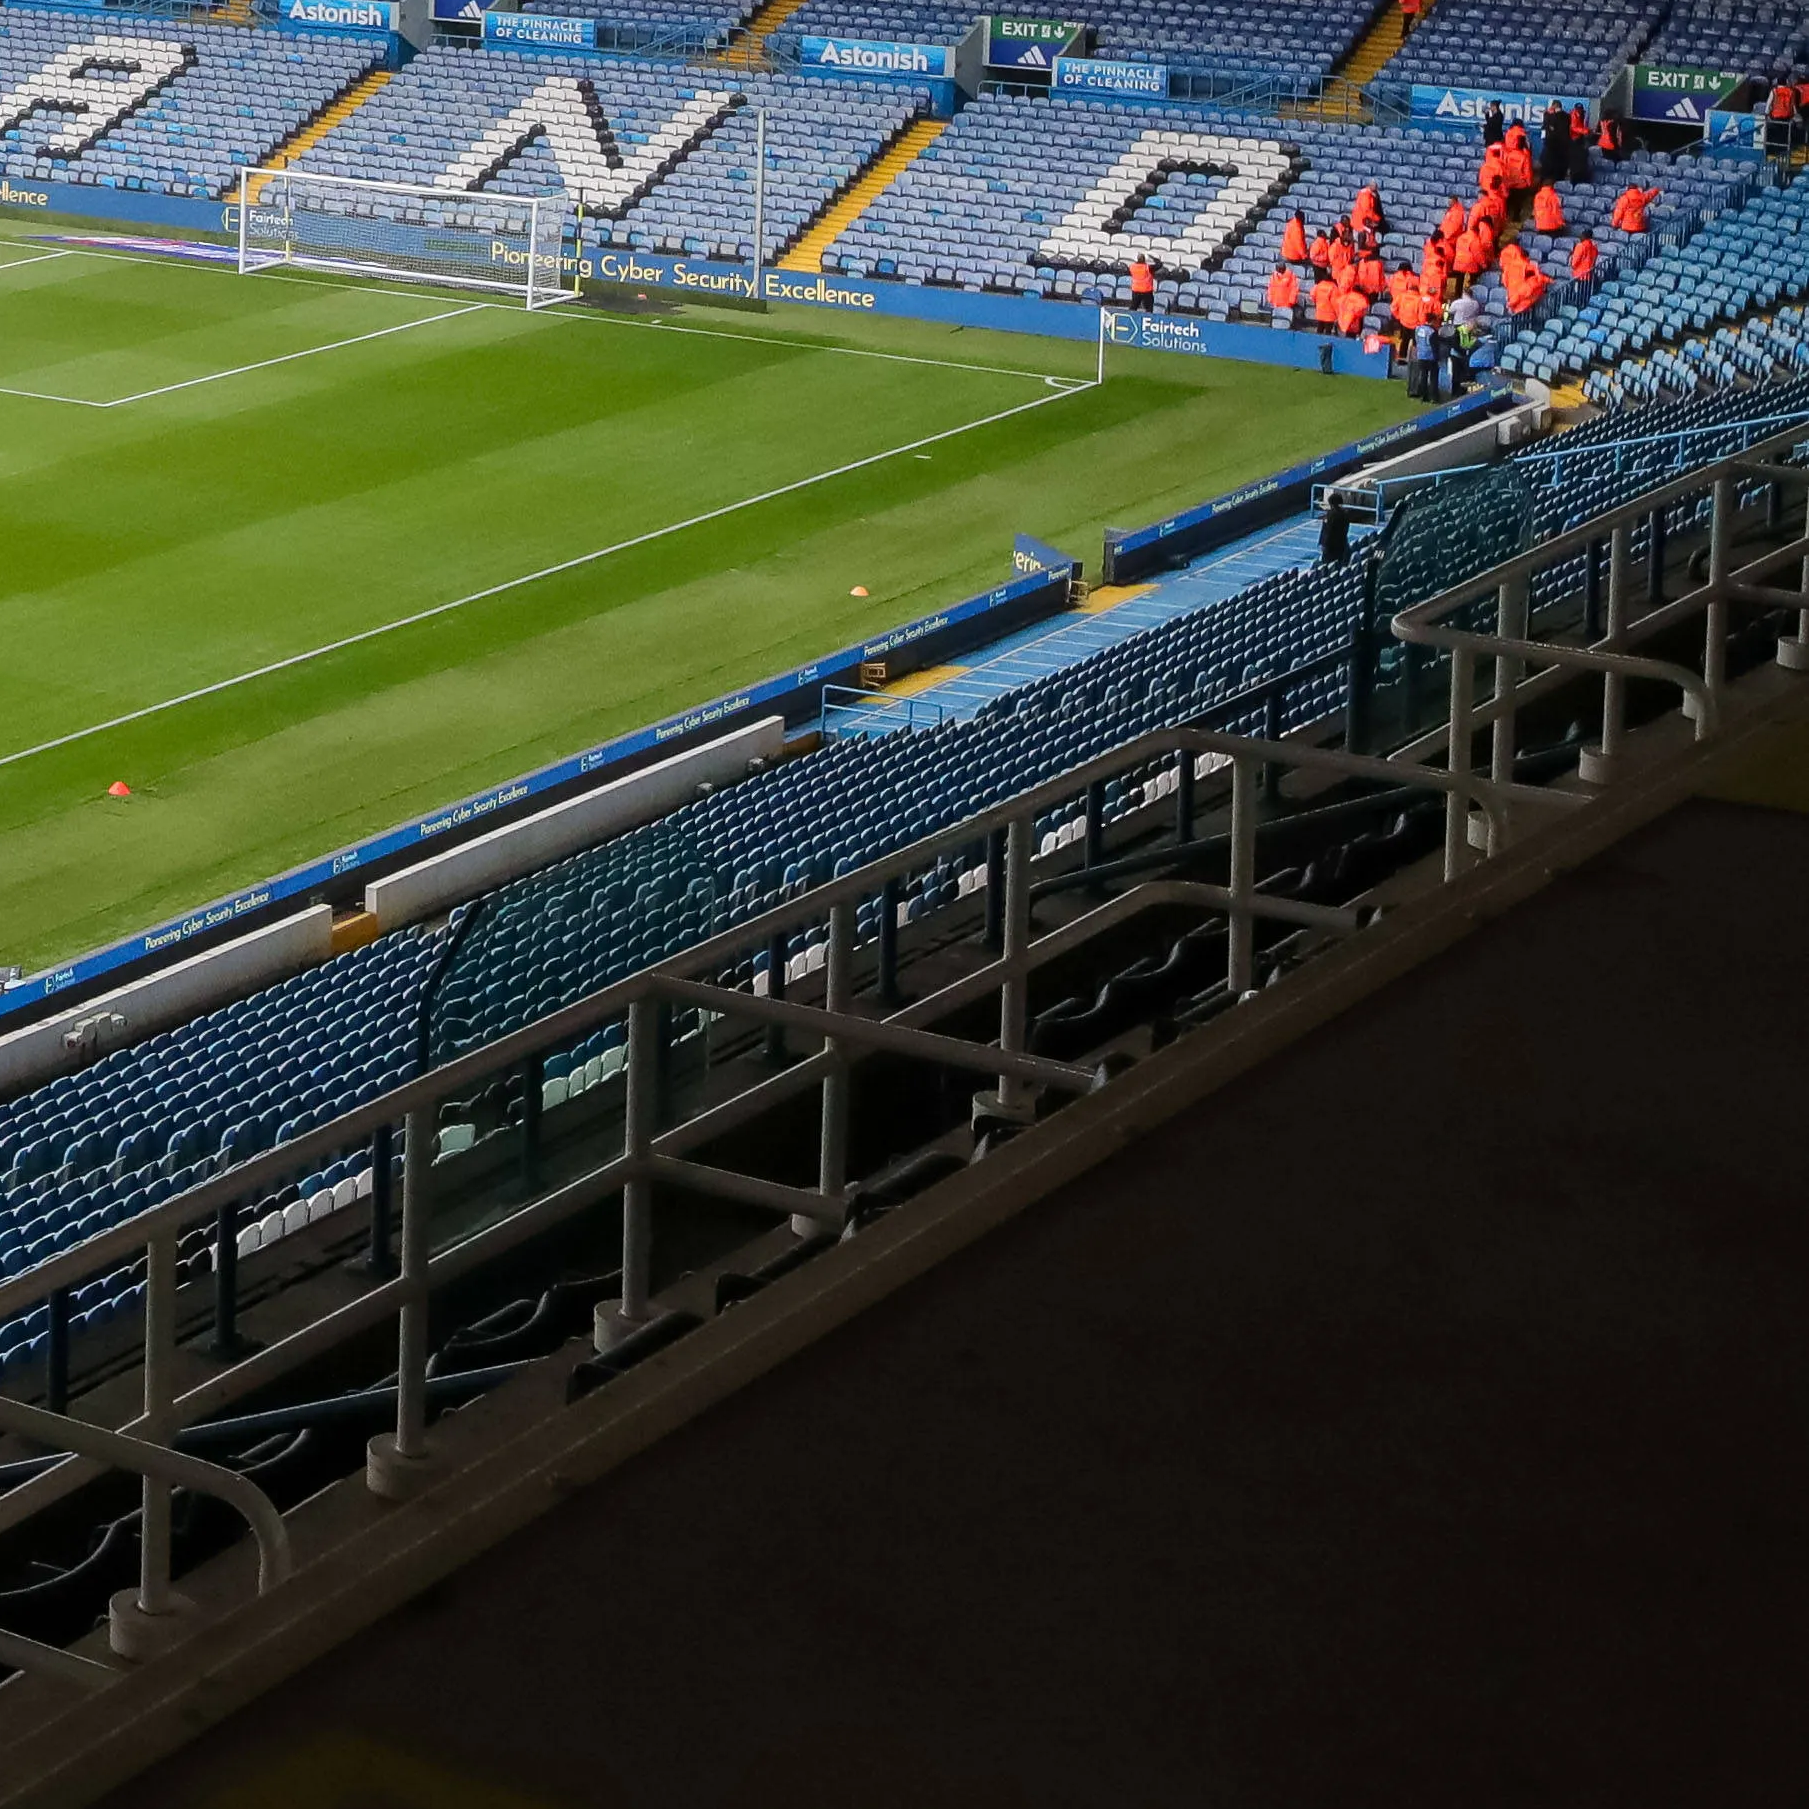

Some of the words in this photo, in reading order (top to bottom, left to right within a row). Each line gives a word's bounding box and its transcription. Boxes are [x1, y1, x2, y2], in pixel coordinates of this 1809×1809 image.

[496, 15, 519, 27] THE
[521, 16, 583, 33] PINNACLE
[1002, 22, 1038, 36] EXIT
[496, 28, 513, 37] OF
[517, 28, 582, 43] CLEANING
[821, 40, 927, 72] Astonish
[1065, 63, 1090, 77] THE
[1092, 65, 1162, 81] PINNACLE
[1648, 71, 1689, 88] EXIT
[1064, 75, 1082, 84] OF
[1088, 76, 1160, 91] CLEANING
[492, 240, 594, 280] Pioneering
[602, 256, 663, 282] Cyber
[674, 261, 756, 296] Security
[766, 273, 874, 307] Excellence
[1142, 318, 1198, 338] Fairtech
[1142, 331, 1206, 352] Solutions
